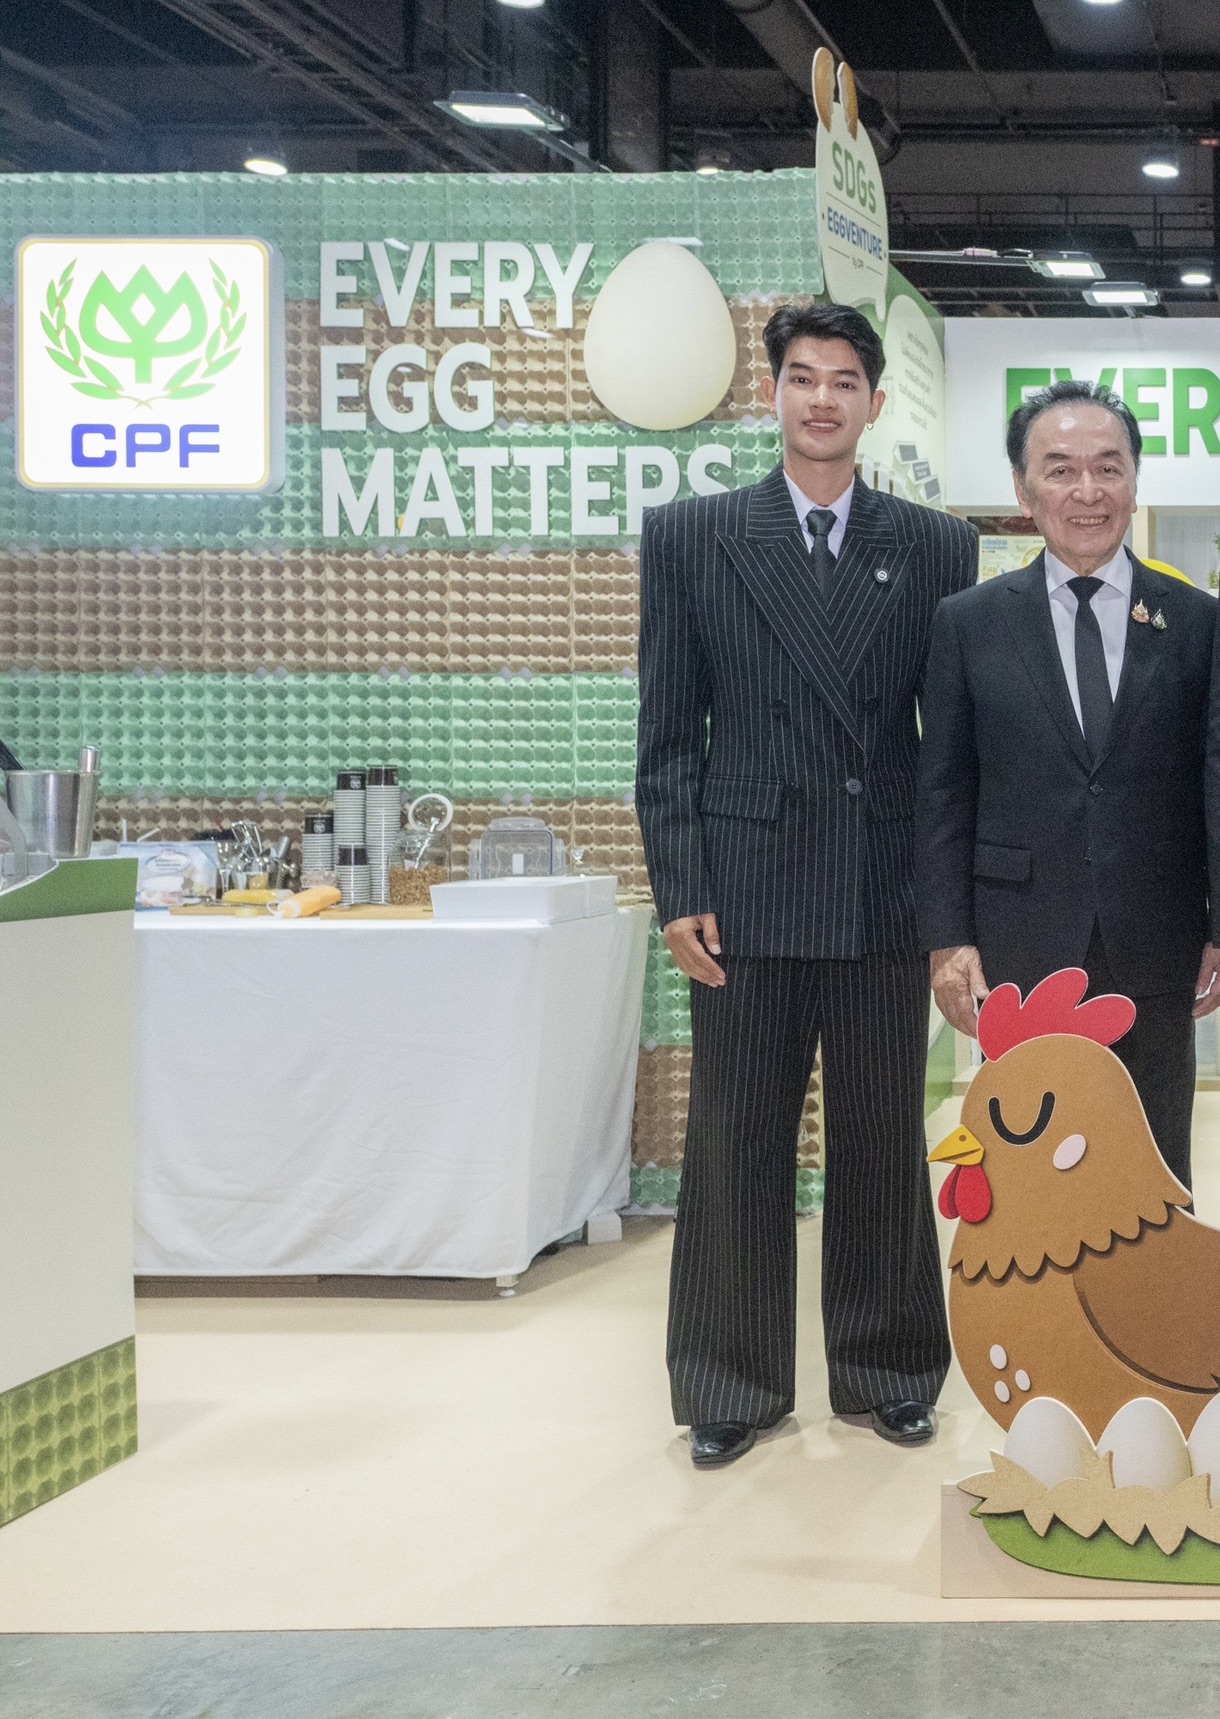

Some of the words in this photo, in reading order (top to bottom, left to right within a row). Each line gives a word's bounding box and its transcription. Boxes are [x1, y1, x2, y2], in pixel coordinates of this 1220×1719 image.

[832, 141, 876, 214] SDGs
[827, 206, 883, 261] EGGVENTURE
[320, 241, 594, 329] EVERY
[320, 342, 494, 432] EGG
[71, 423, 220, 468] CPF
